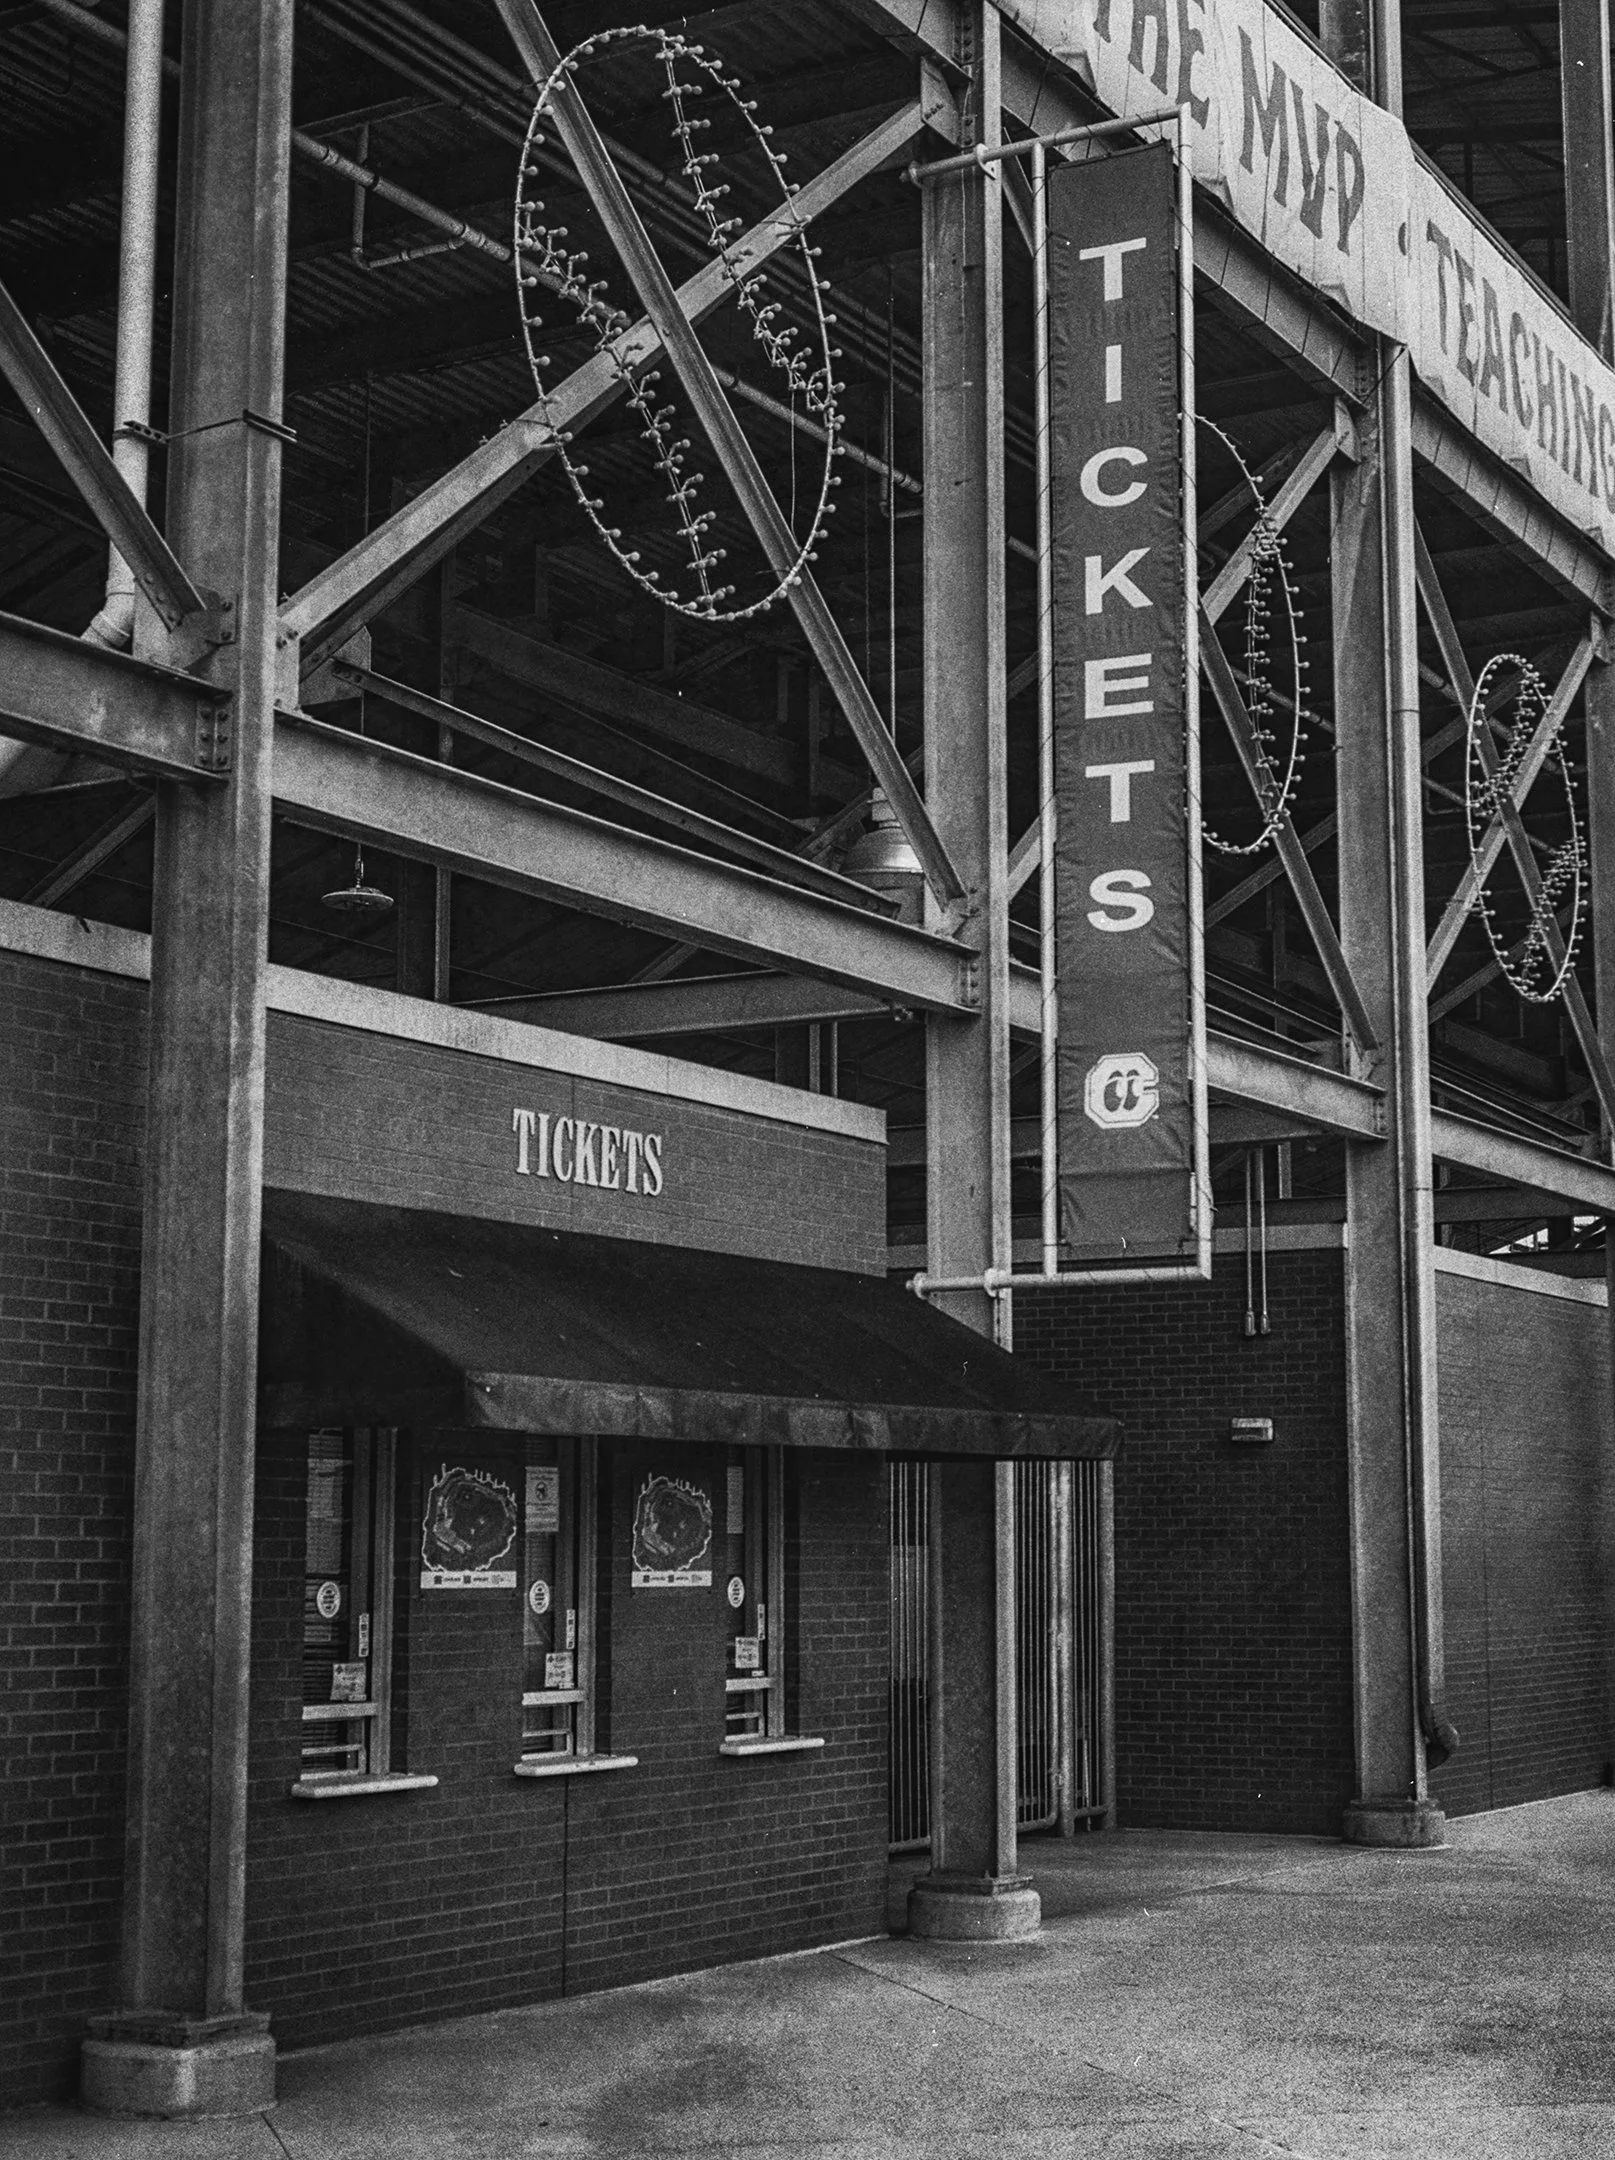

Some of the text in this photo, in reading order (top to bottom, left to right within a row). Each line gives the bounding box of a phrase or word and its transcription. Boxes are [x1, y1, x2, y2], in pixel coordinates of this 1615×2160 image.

[1093, 0, 1209, 130] HE
[1237, 24, 1366, 257] MVP
[1079, 236, 1155, 933] TICKETS
[512, 1107, 663, 1197] TICKETS
